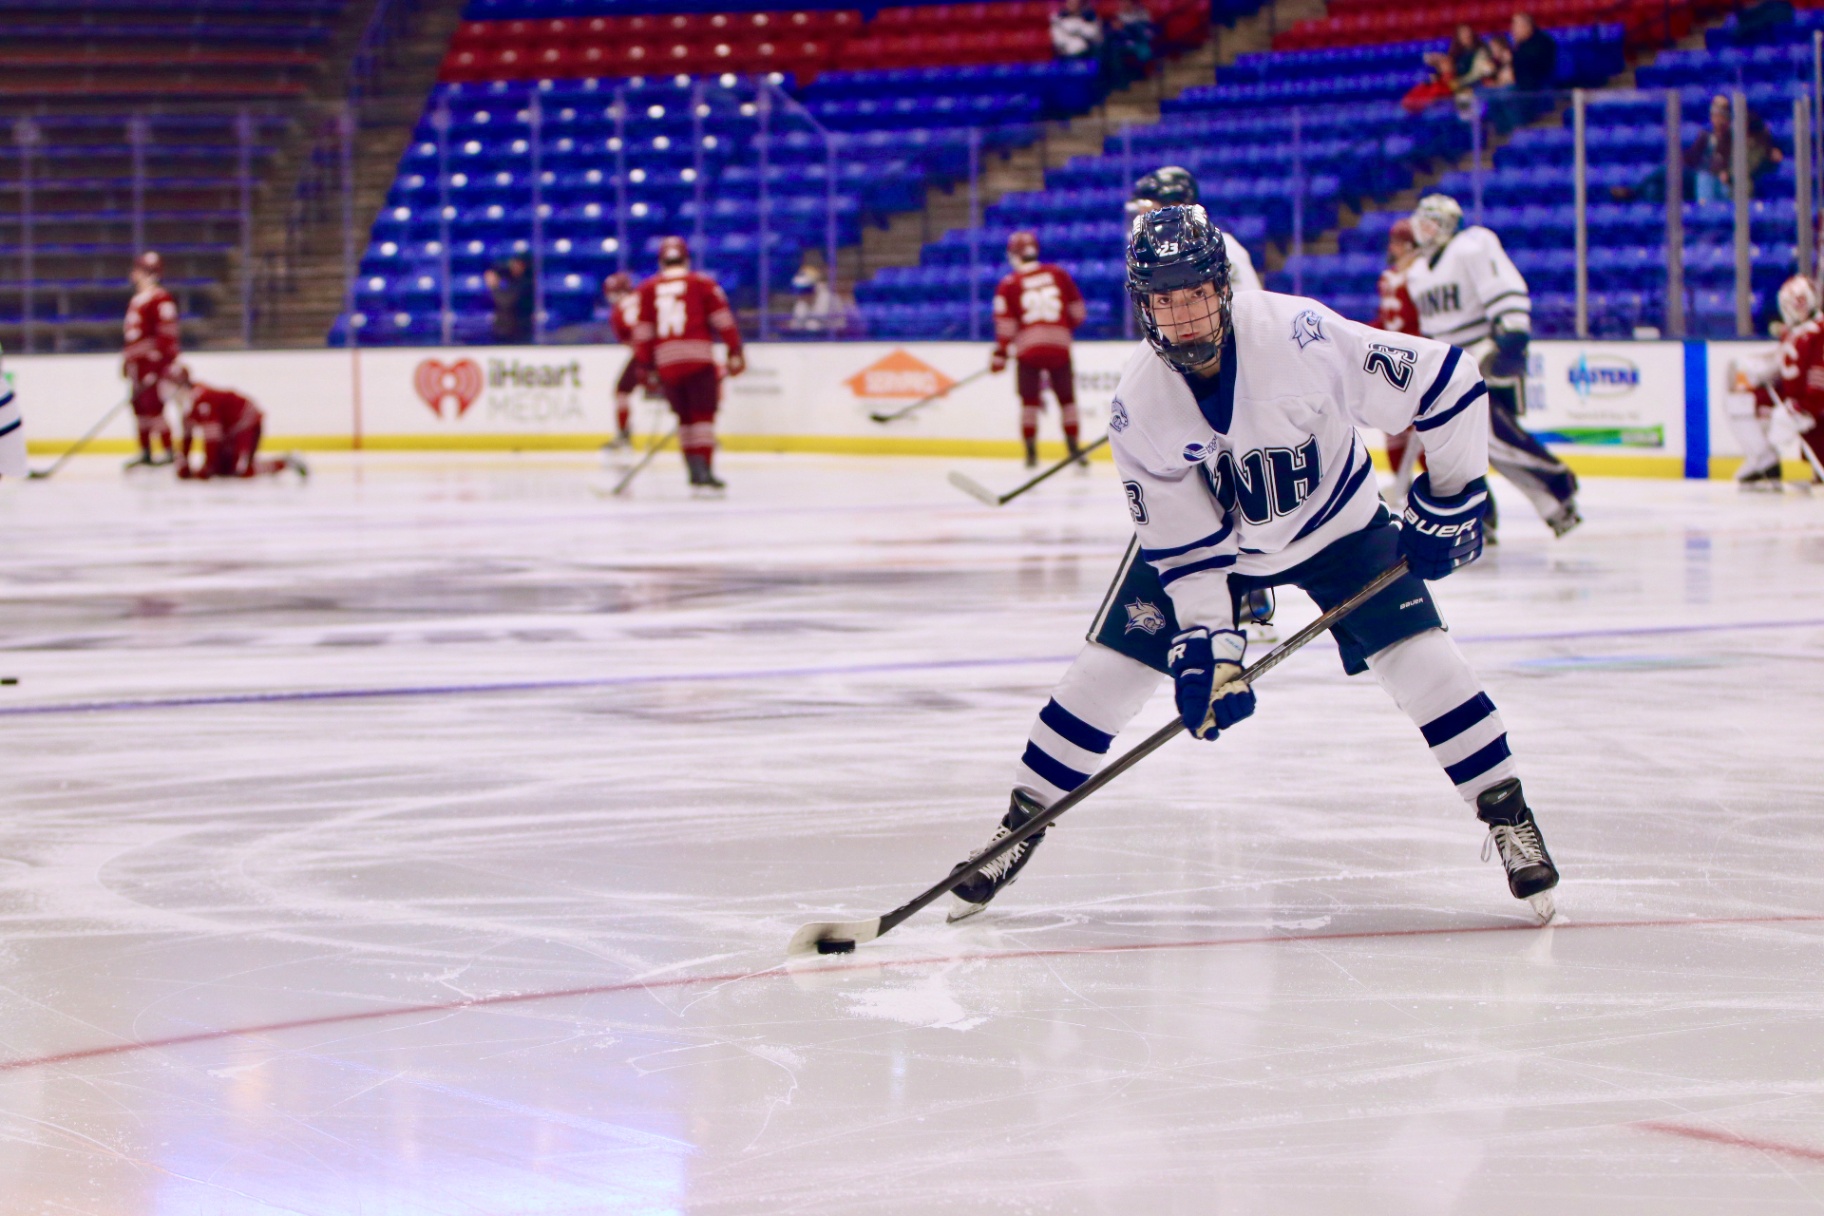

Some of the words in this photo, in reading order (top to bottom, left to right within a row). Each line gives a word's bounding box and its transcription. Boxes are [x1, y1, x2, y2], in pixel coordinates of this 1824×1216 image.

[1159, 243, 1178, 258] 23
[489, 358, 581, 388] iHeart
[488, 394, 585, 421] MEDIA
[1404, 507, 1478, 538] AUER
